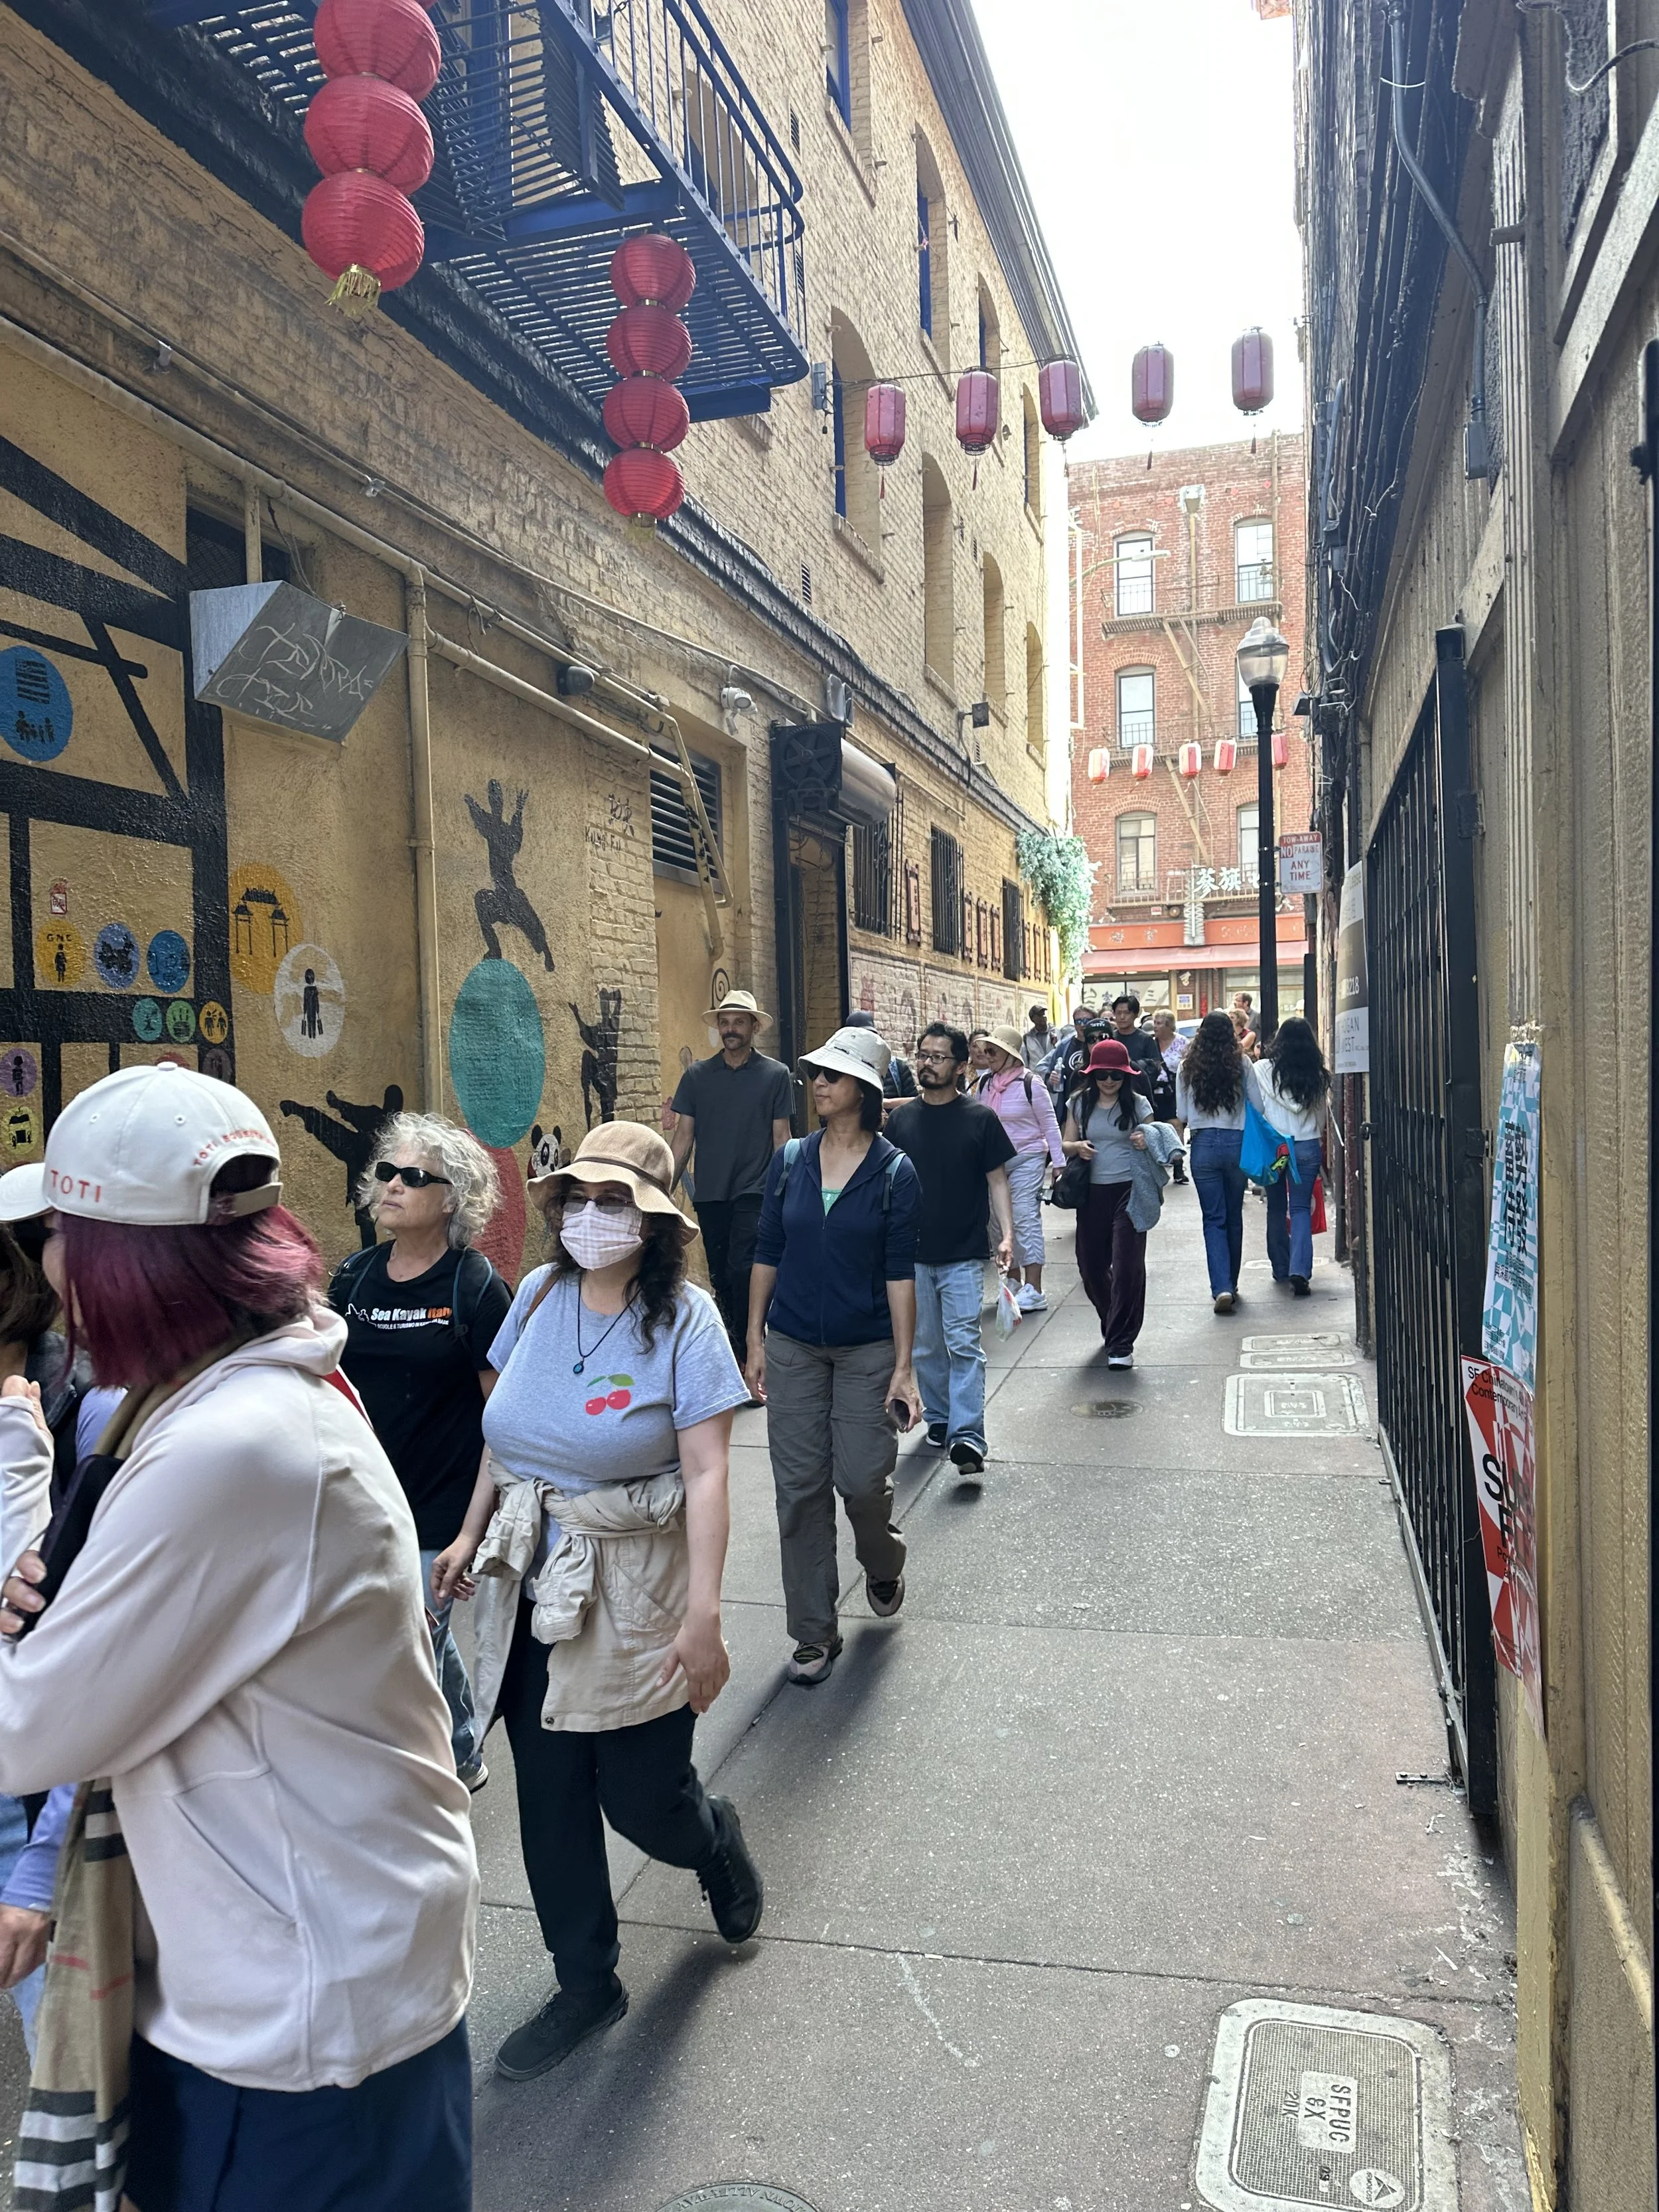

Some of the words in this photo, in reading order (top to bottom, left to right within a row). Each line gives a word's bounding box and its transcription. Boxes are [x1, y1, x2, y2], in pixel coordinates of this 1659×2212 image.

[1283, 834, 1318, 844] TOW-AWAY
[1281, 846, 1293, 857] NO
[1294, 845, 1319, 854] PARKING
[1291, 860, 1309, 870] ANY
[1289, 871, 1311, 881] TIME
[193, 1141, 218, 1167] TOTI
[50, 1169, 102, 1203] TOTI
[371, 1307, 391, 1321] Sea
[392, 1307, 427, 1321] Kayak
[427, 1307, 453, 1319] Italy
[1468, 1366, 1479, 1380] SF
[1471, 1383, 1520, 1419] Contemporary
[1281, 2091, 1299, 2118] 20K
[1329, 2084, 1352, 2143] SFPUC
[676, 2185, 761, 2211] ALLEYWAY
